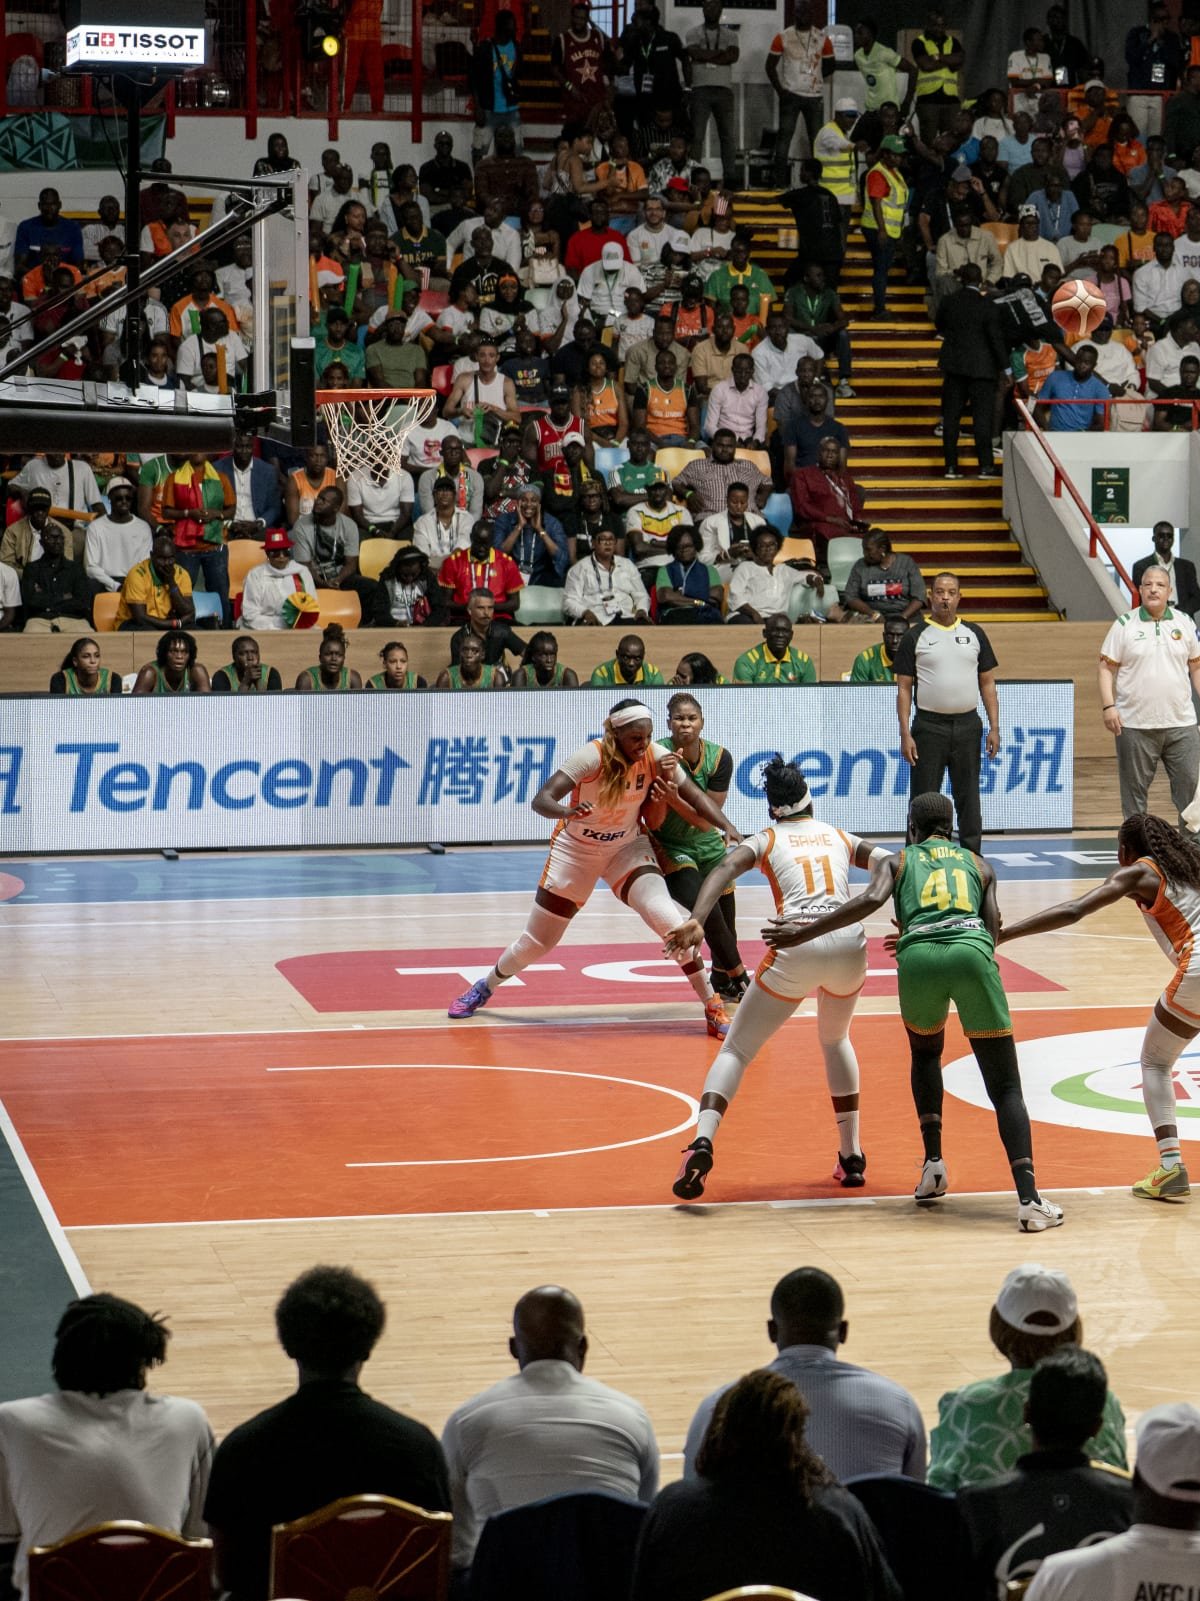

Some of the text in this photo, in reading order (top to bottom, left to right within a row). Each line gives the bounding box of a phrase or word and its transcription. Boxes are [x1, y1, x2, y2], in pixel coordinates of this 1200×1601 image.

[119, 33, 198, 49] TISSOT
[516, 368, 539, 379] BEST
[1106, 487, 1115, 499] 2
[55, 742, 411, 813] Tencent
[417, 736, 557, 805] 腾讯
[795, 854, 835, 896] 11
[921, 867, 973, 912] 41
[1135, 1581, 1185, 1601] AVEC
